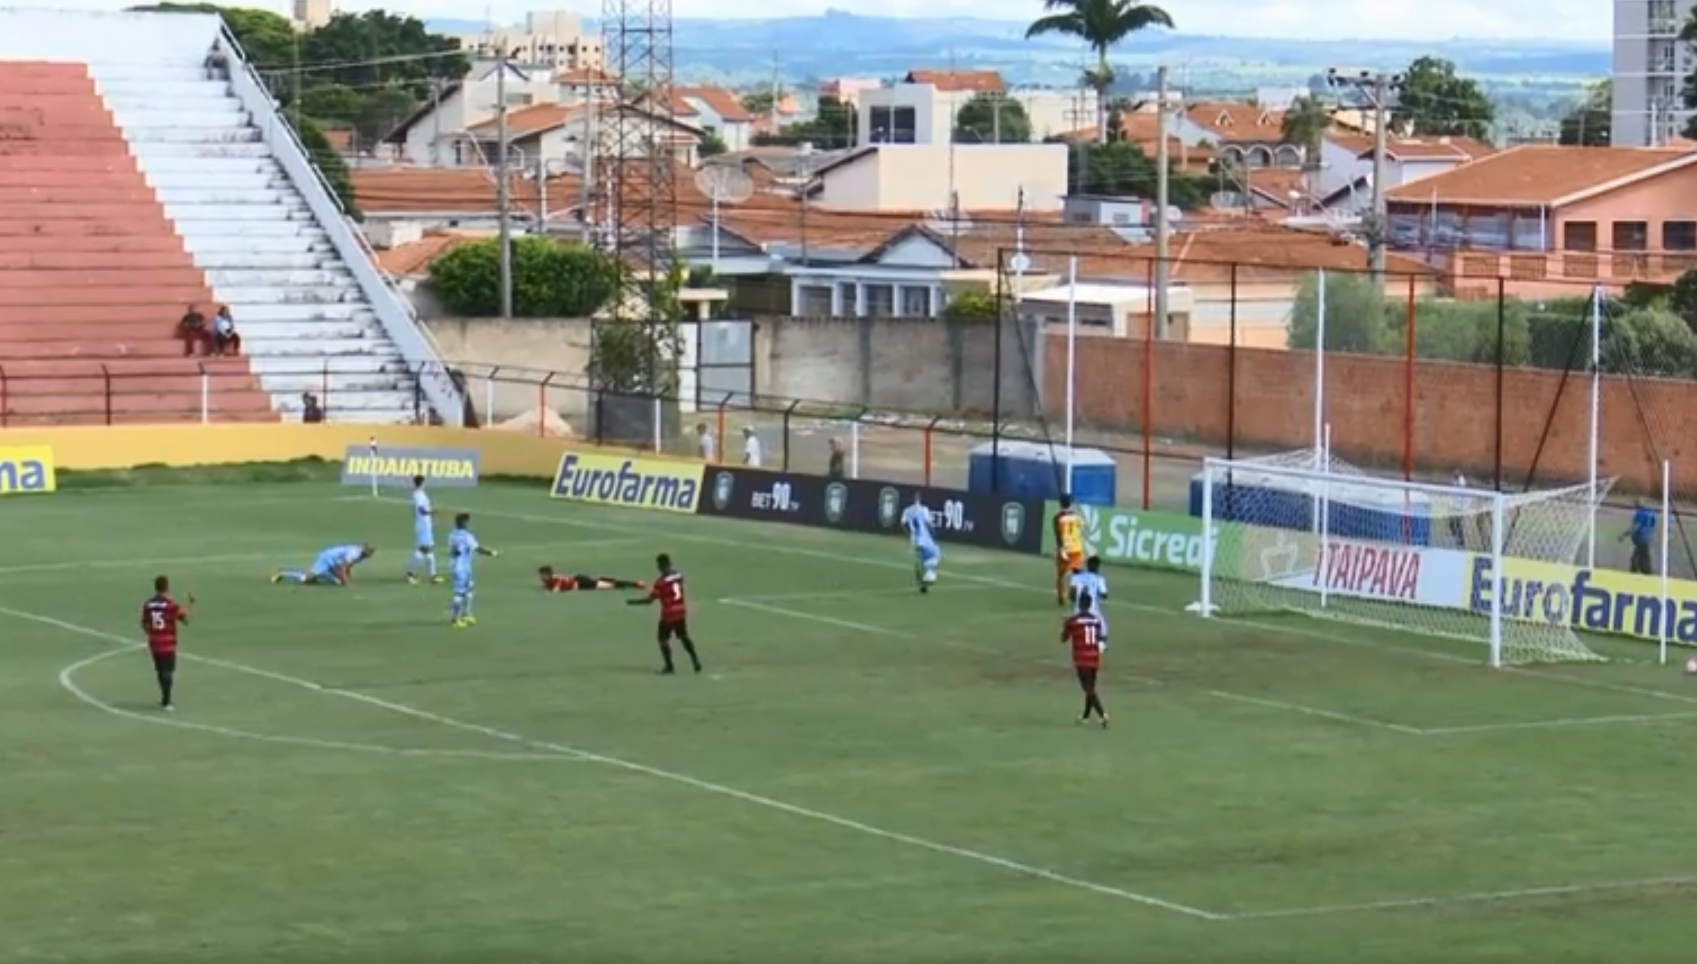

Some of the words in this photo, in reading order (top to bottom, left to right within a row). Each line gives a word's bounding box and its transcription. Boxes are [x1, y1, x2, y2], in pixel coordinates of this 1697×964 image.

[347, 456, 474, 478] INDAIATUBA
[554, 454, 697, 509] Eurofarma
[1105, 514, 1218, 568] Sicredi
[1313, 543, 1421, 599] ITAIPAVA
[1470, 556, 1697, 642] Eurofarma
[1084, 624, 1097, 644] 11
